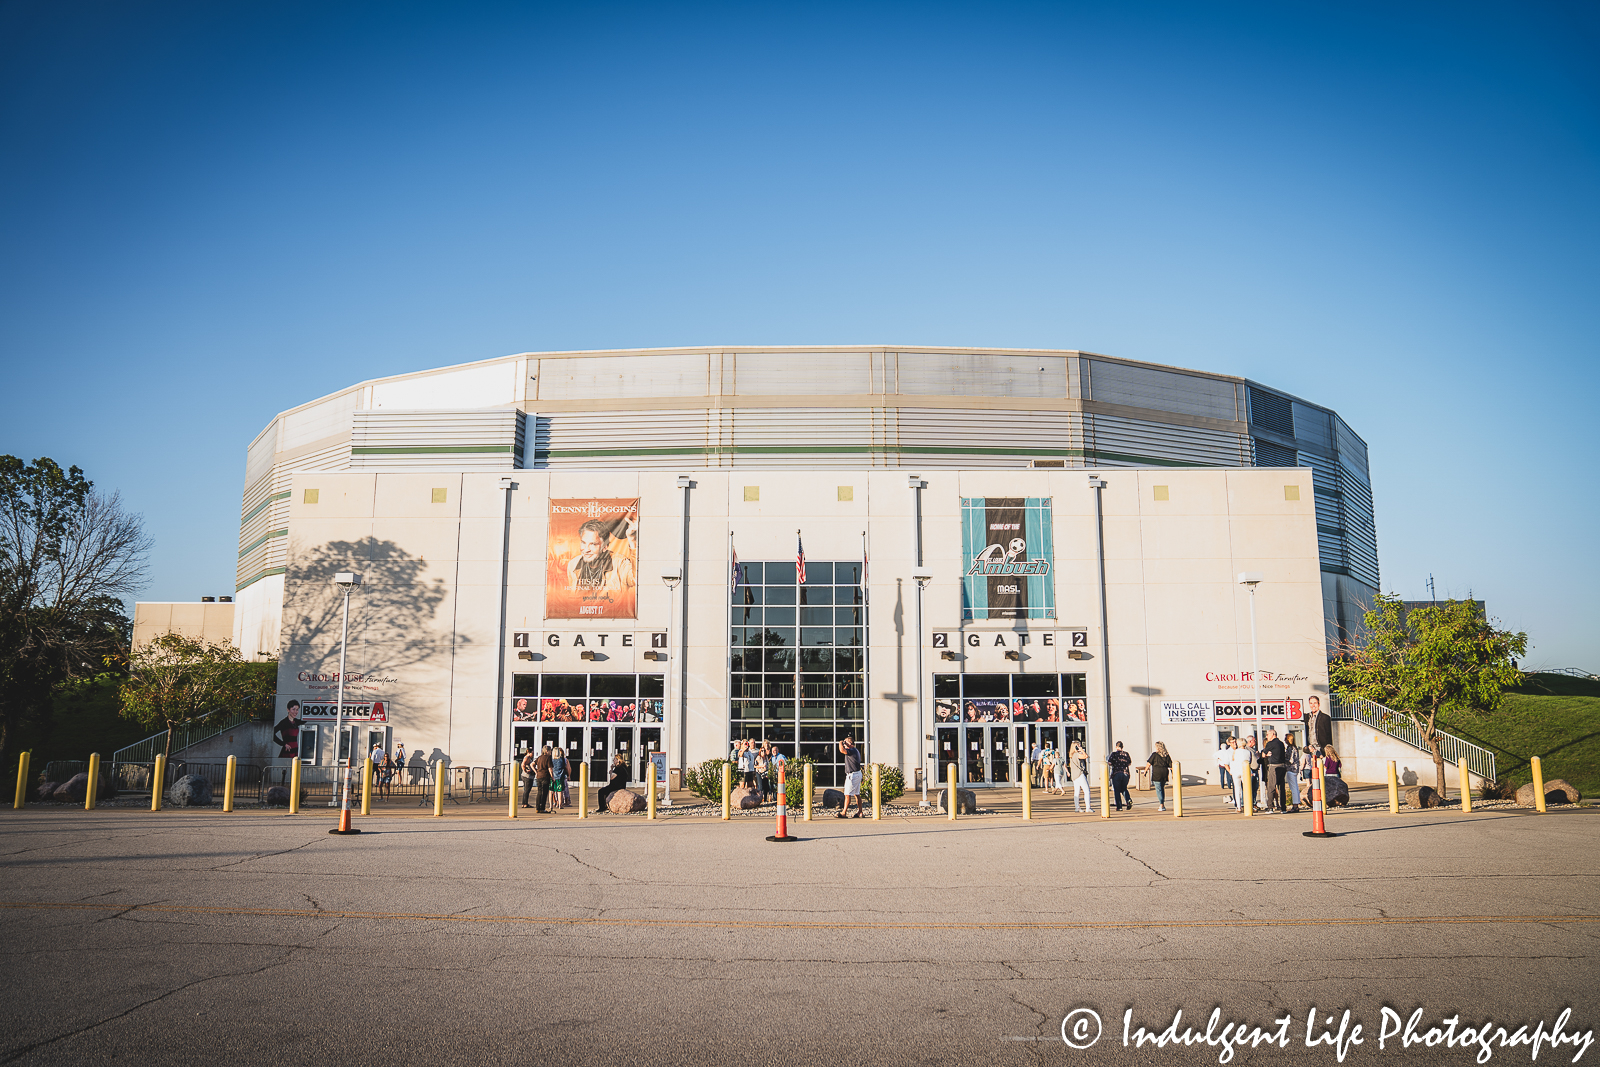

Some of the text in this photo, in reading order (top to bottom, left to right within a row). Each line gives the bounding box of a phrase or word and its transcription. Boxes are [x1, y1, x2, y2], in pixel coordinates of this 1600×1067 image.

[552, 506, 589, 514] KENNY
[967, 554, 1050, 576] Ambush
[997, 585, 1020, 593] MASL
[579, 606, 603, 614] AUGUST 17
[516, 634, 662, 647] 1 GATE 1
[935, 634, 1084, 647] 2 GATE 2
[298, 672, 329, 682] CAROL
[365, 675, 398, 686] Furniture
[1206, 672, 1238, 682] CAROL
[1275, 674, 1308, 684] Furniture
[303, 706, 328, 715] BOX
[370, 702, 386, 721] A
[1216, 706, 1241, 715] BOX
[1244, 705, 1284, 716] OFICE
[1286, 701, 1302, 720] B
